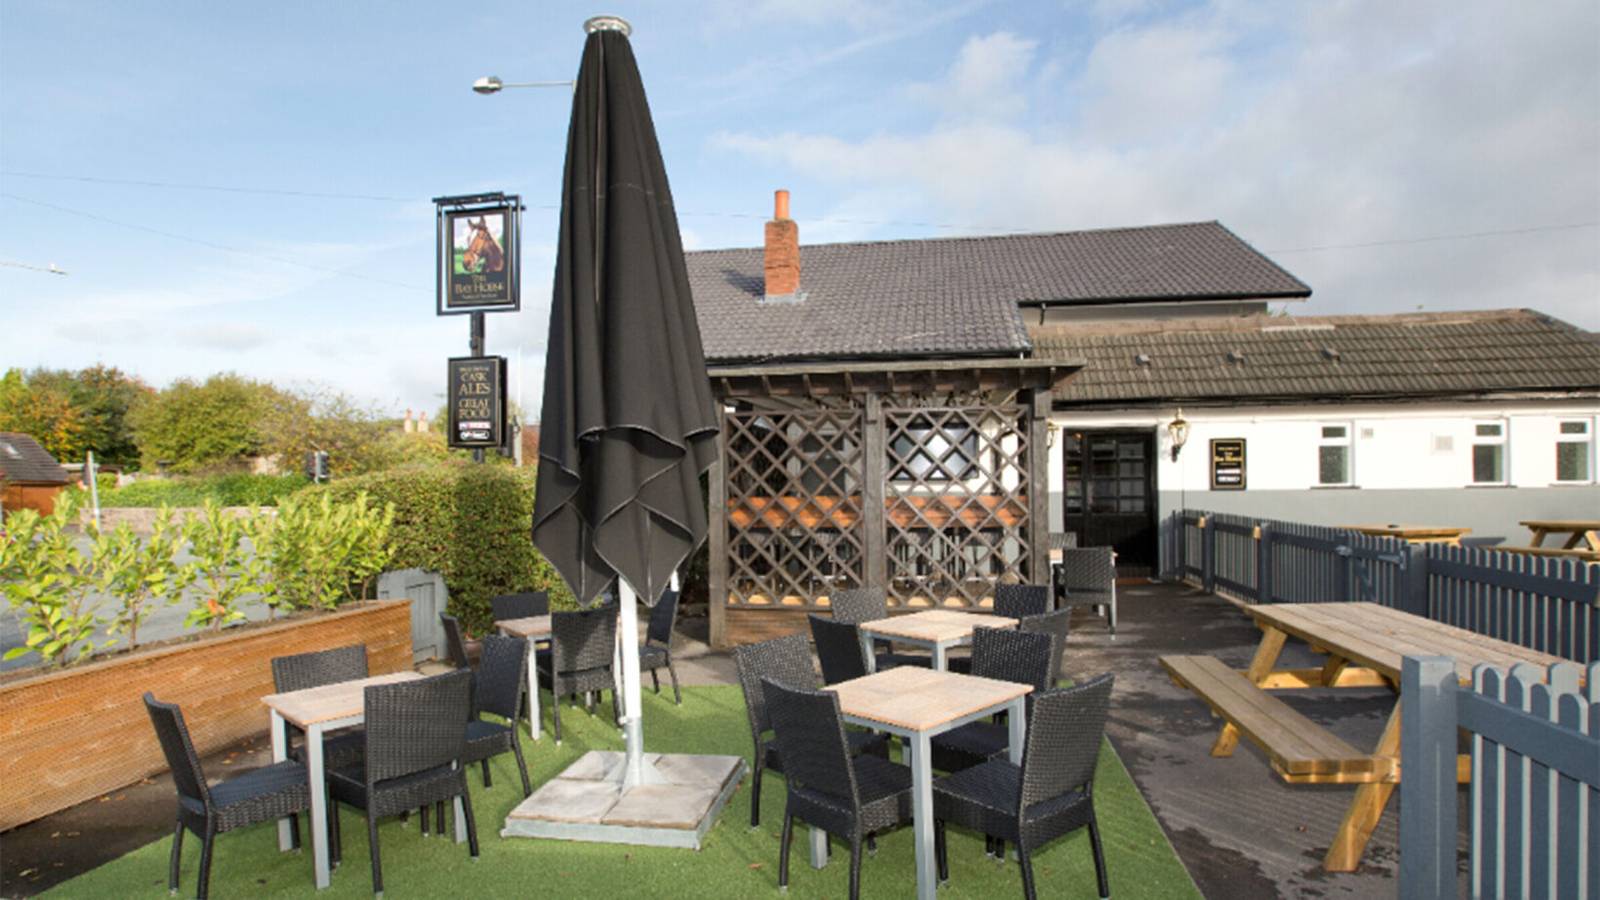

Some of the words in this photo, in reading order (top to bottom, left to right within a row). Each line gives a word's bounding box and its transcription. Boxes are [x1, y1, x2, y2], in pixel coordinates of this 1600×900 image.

[460, 372, 487, 381] CASK
[459, 383, 490, 395] ALES
[459, 399, 489, 409] GREAT
[459, 408, 490, 418] FOOD
